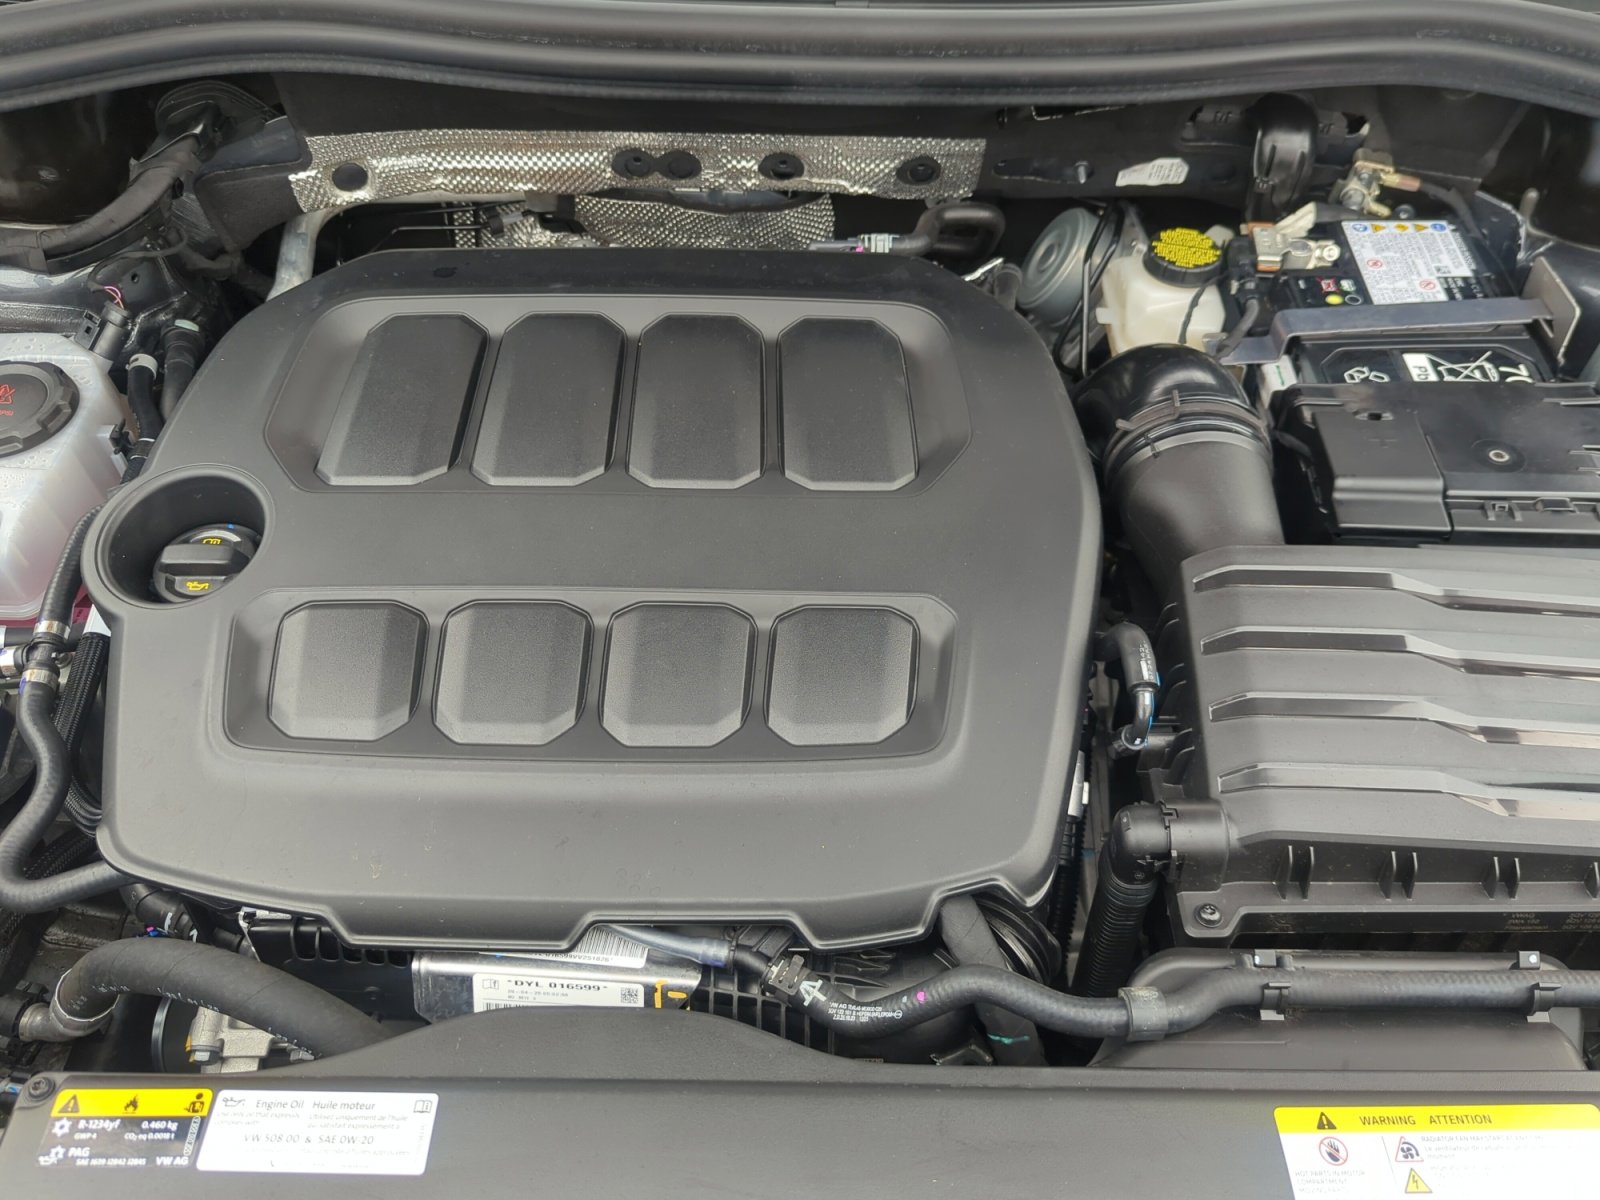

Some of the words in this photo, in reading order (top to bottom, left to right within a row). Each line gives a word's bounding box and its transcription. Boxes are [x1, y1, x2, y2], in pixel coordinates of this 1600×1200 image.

[1412, 366, 1430, 380] Pb
[256, 1099, 289, 1110] Engine
[290, 1099, 304, 1109] Oil
[312, 1100, 338, 1110] Huile
[340, 1101, 376, 1110] moteur
[78, 1118, 121, 1132] R-1234yf
[1359, 1115, 1416, 1126] WARNING
[1429, 1114, 1492, 1125] ATTENTION
[141, 1120, 166, 1129] 0.460
[167, 1120, 178, 1132] kg
[244, 1133, 261, 1142] VW
[264, 1133, 284, 1143] 508
[285, 1133, 300, 1143] 00
[304, 1135, 312, 1144] &
[318, 1134, 337, 1144] SAE
[68, 1146, 90, 1157] PAG
[156, 1156, 173, 1166] VW
[173, 1156, 189, 1166] AG
